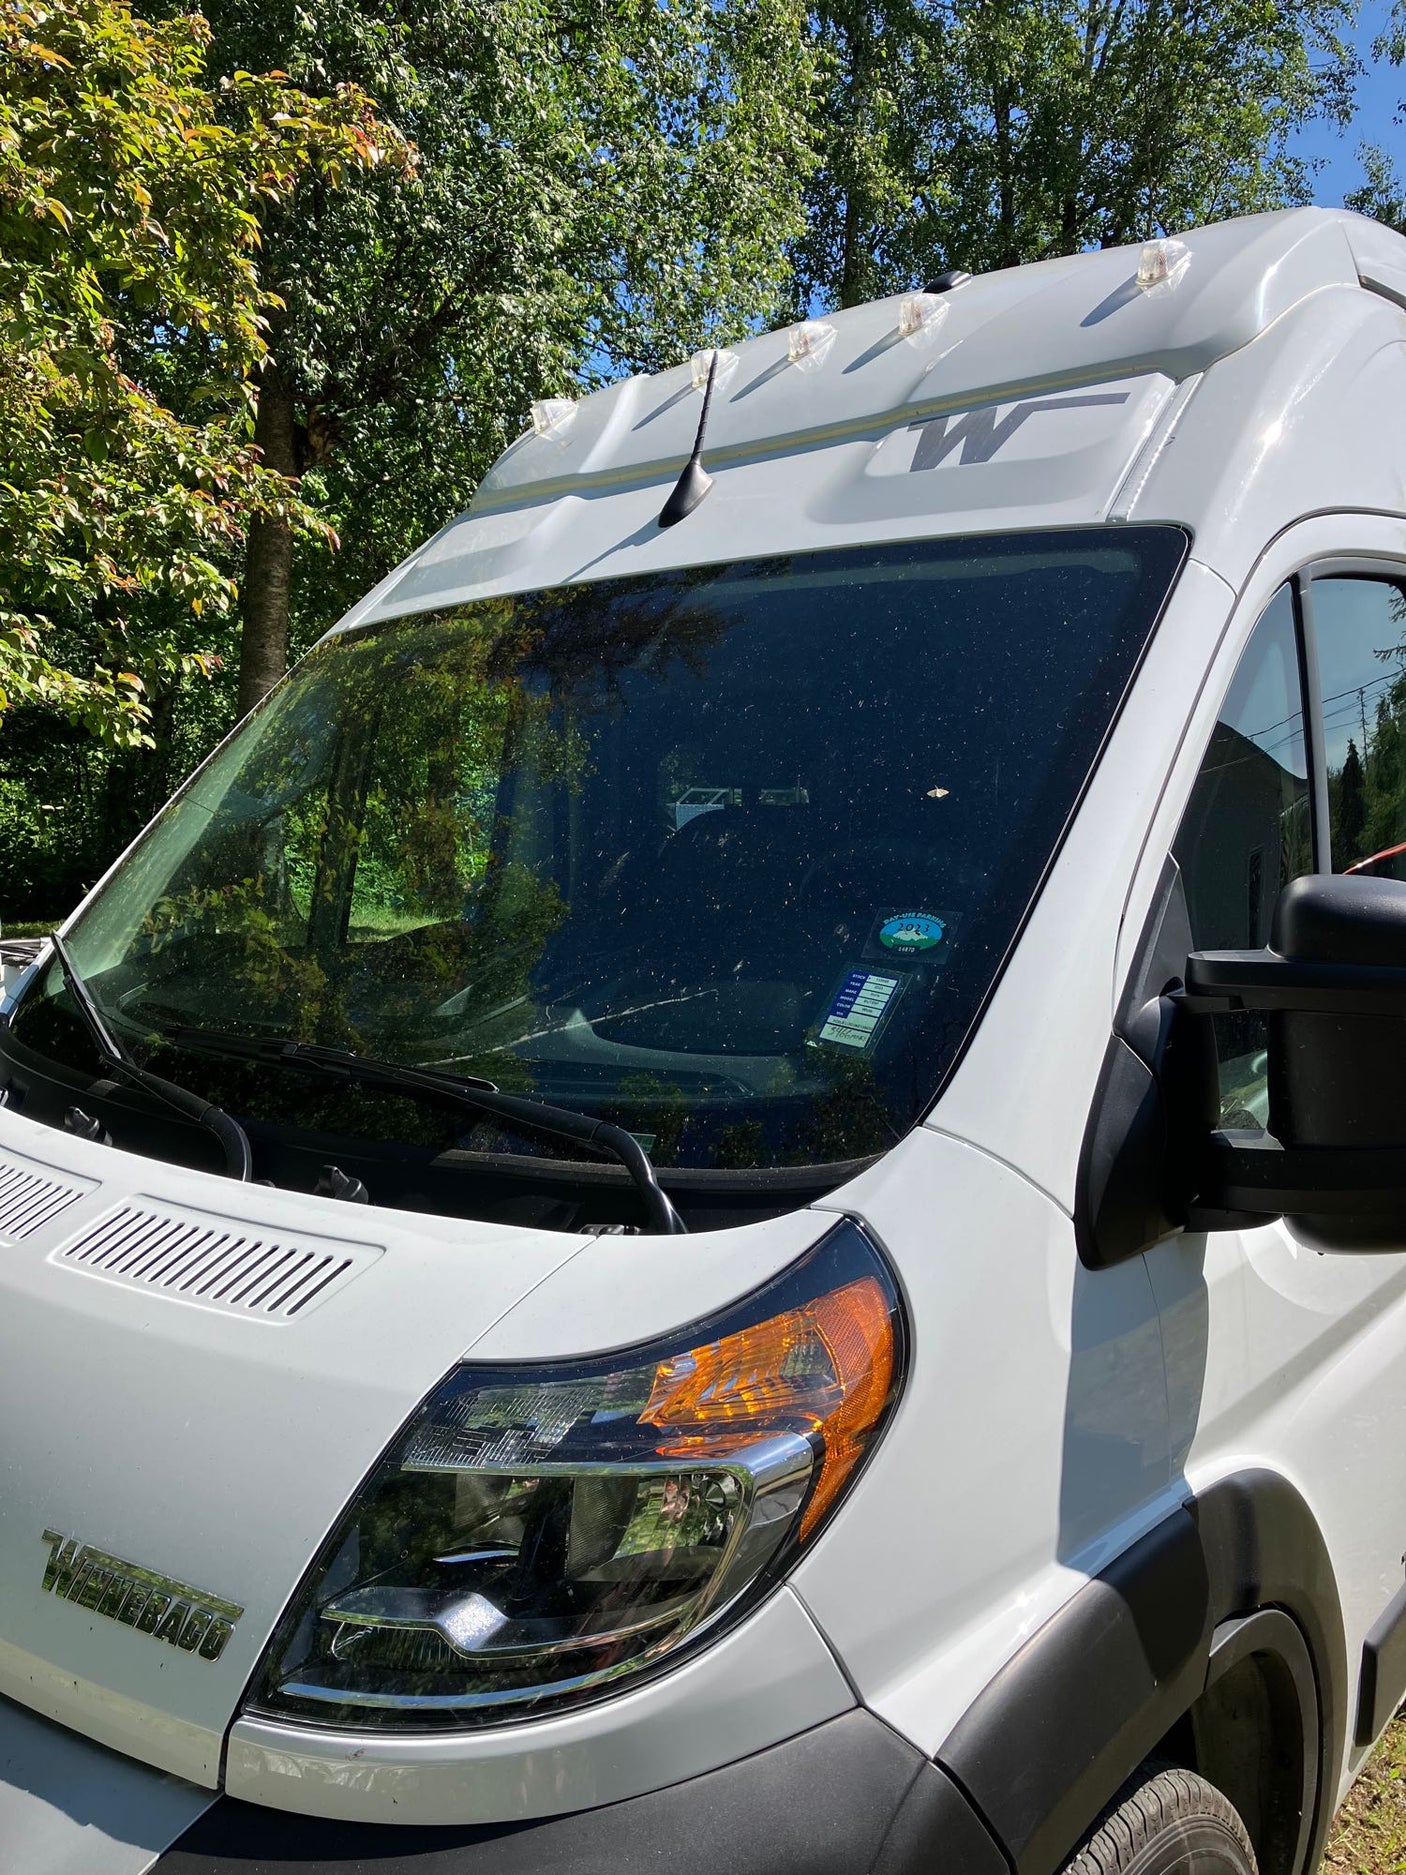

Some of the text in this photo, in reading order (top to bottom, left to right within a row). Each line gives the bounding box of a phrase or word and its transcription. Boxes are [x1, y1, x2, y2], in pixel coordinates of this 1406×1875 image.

[883, 912, 947, 929] DAY-USE PARKING
[898, 922, 930, 933] 2023
[41, 1528, 245, 1662] WINNEBAGO
